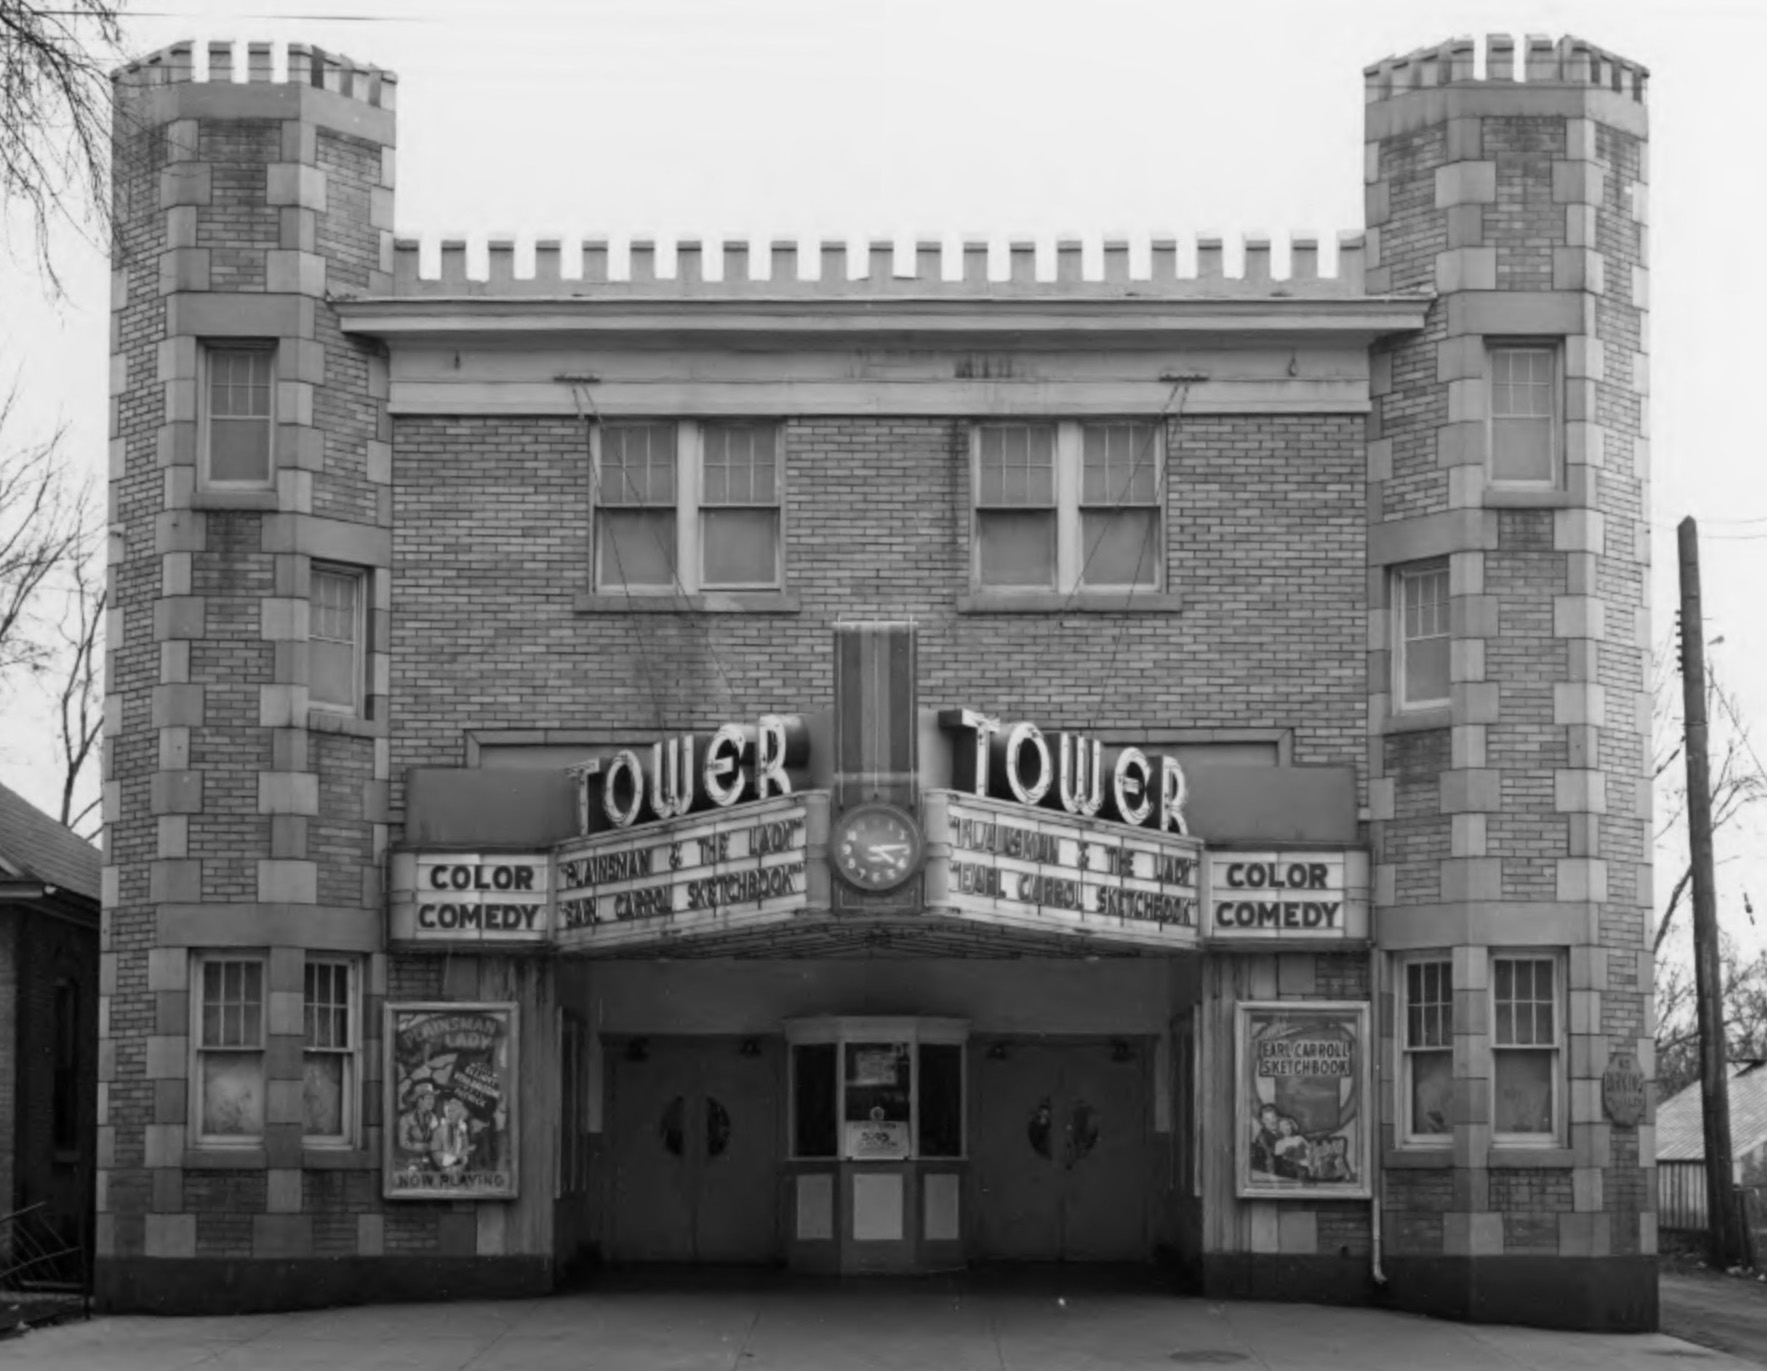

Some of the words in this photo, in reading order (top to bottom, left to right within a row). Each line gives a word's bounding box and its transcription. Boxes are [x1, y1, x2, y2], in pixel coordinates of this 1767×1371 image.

[565, 713, 792, 836] TOWER
[959, 708, 1188, 836] TOWER
[669, 841, 681, 871] &
[697, 831, 729, 867] THE
[1078, 841, 1089, 872] &
[1105, 844, 1134, 879] THE
[430, 864, 535, 891] COLOR
[1226, 862, 1329, 889] COLOR
[418, 903, 540, 929] COMEDY
[1215, 901, 1341, 928] COMEDY
[445, 1032, 492, 1051] LADY
[1261, 1041, 1292, 1058] EARL
[1295, 1040, 1348, 1058] CARROLL
[1262, 1059, 1348, 1075] SKETCHBOOK
[397, 1174, 434, 1188] NOW
[440, 1173, 505, 1188] PLAYING
